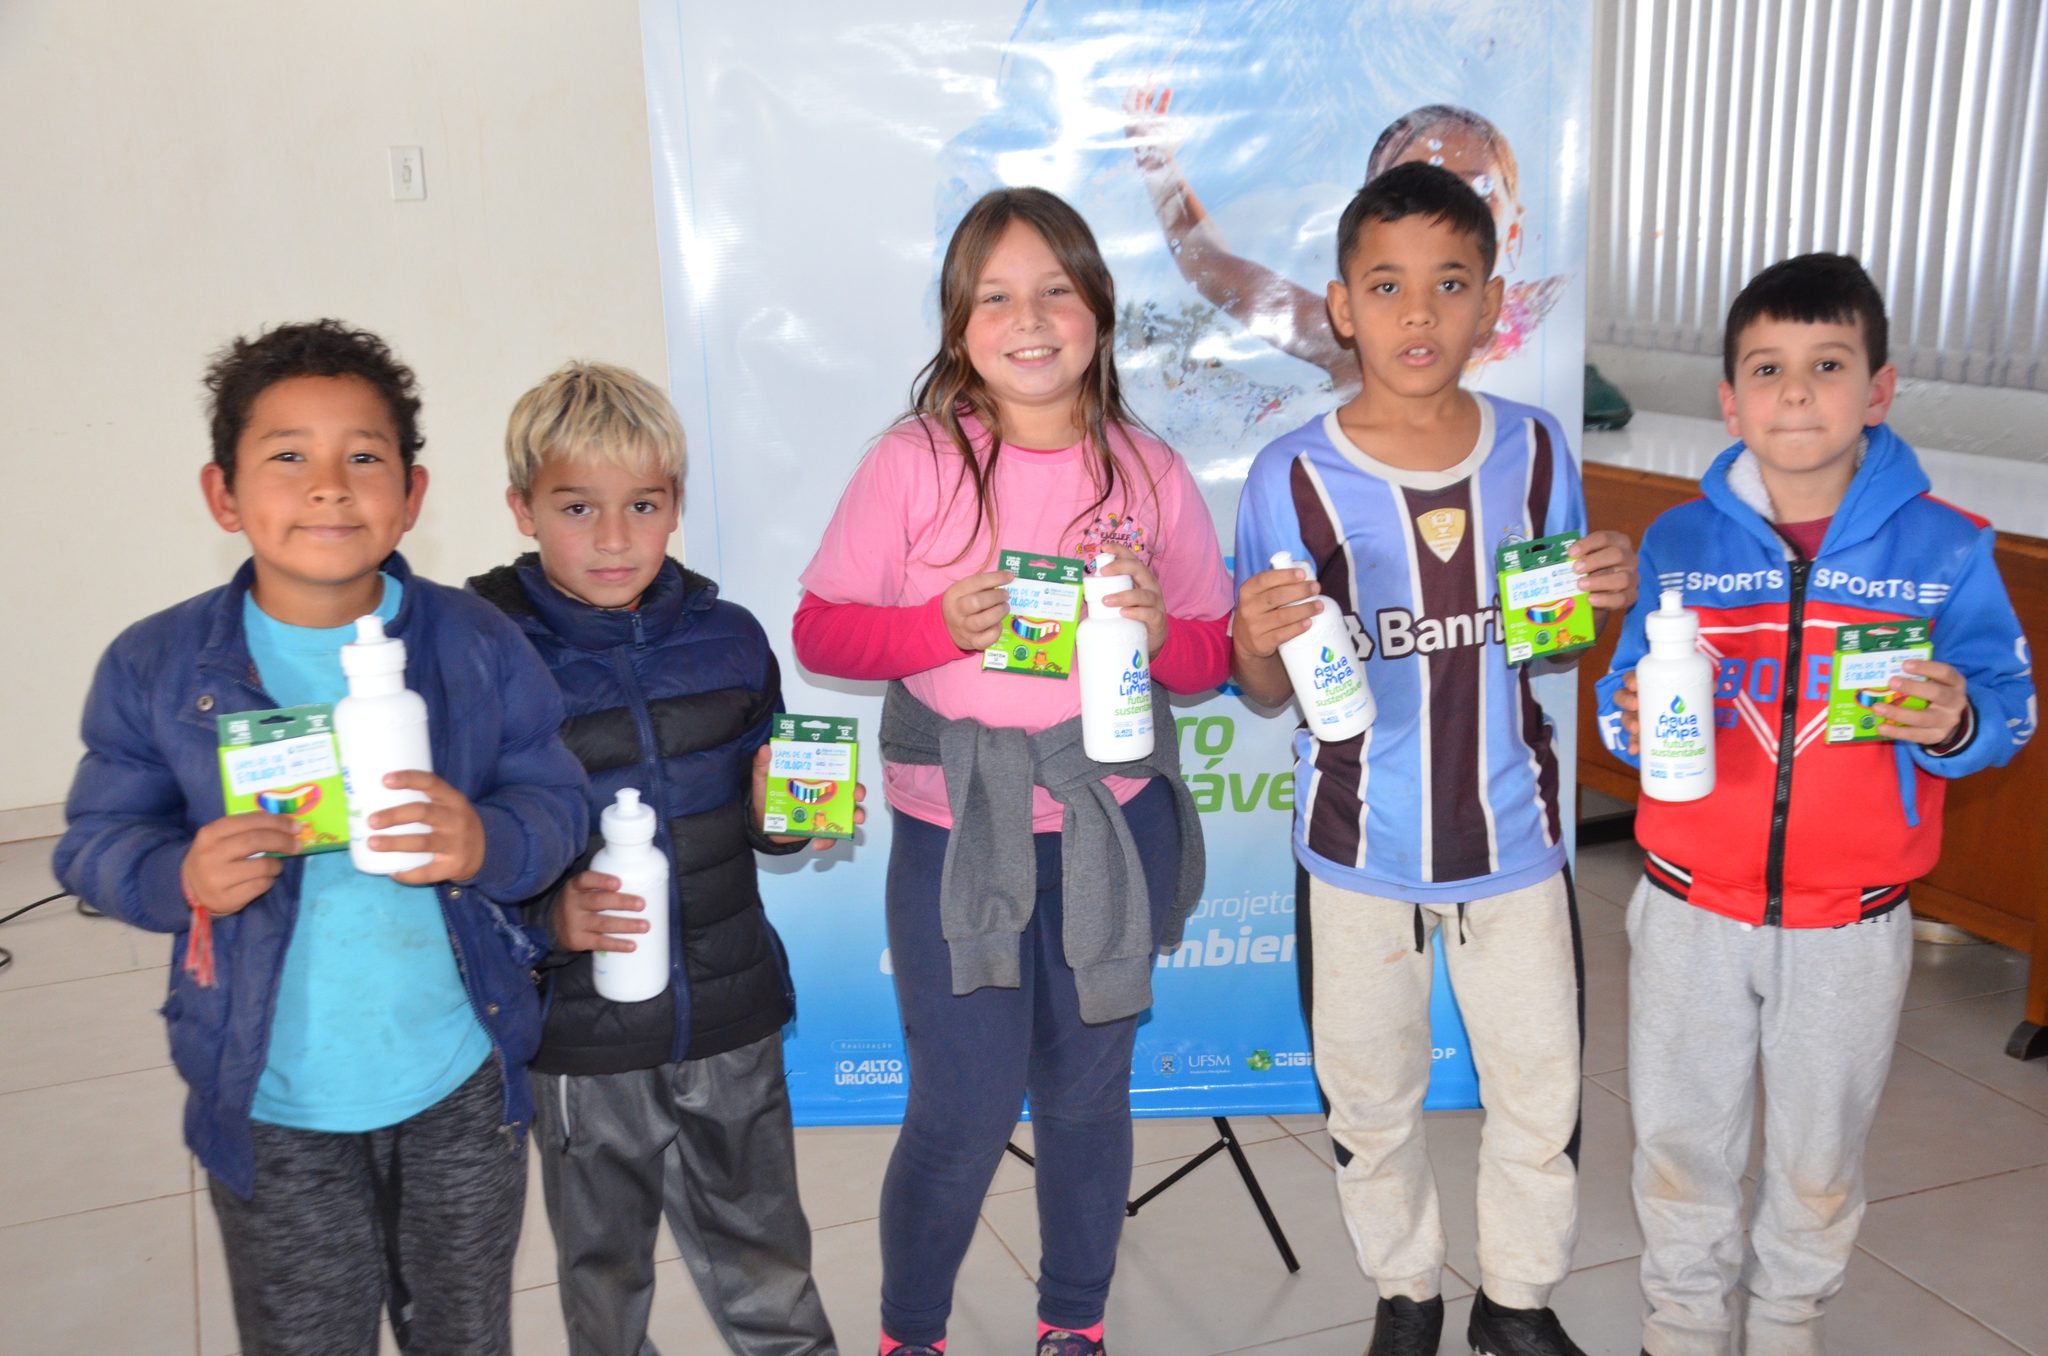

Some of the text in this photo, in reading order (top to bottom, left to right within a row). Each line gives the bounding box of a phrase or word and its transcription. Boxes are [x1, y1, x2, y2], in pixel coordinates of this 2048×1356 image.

[1686, 569, 1784, 593] SPORTS
[1813, 568, 1917, 600] SPORTS
[1314, 666, 1353, 689] Limpa
[1660, 712, 1697, 729] Água
[1655, 726, 1701, 741] Limpa
[856, 1059, 903, 1073] ALTO
[1188, 1055, 1231, 1068] UFSM
[835, 1072, 903, 1086] URUGUAI
